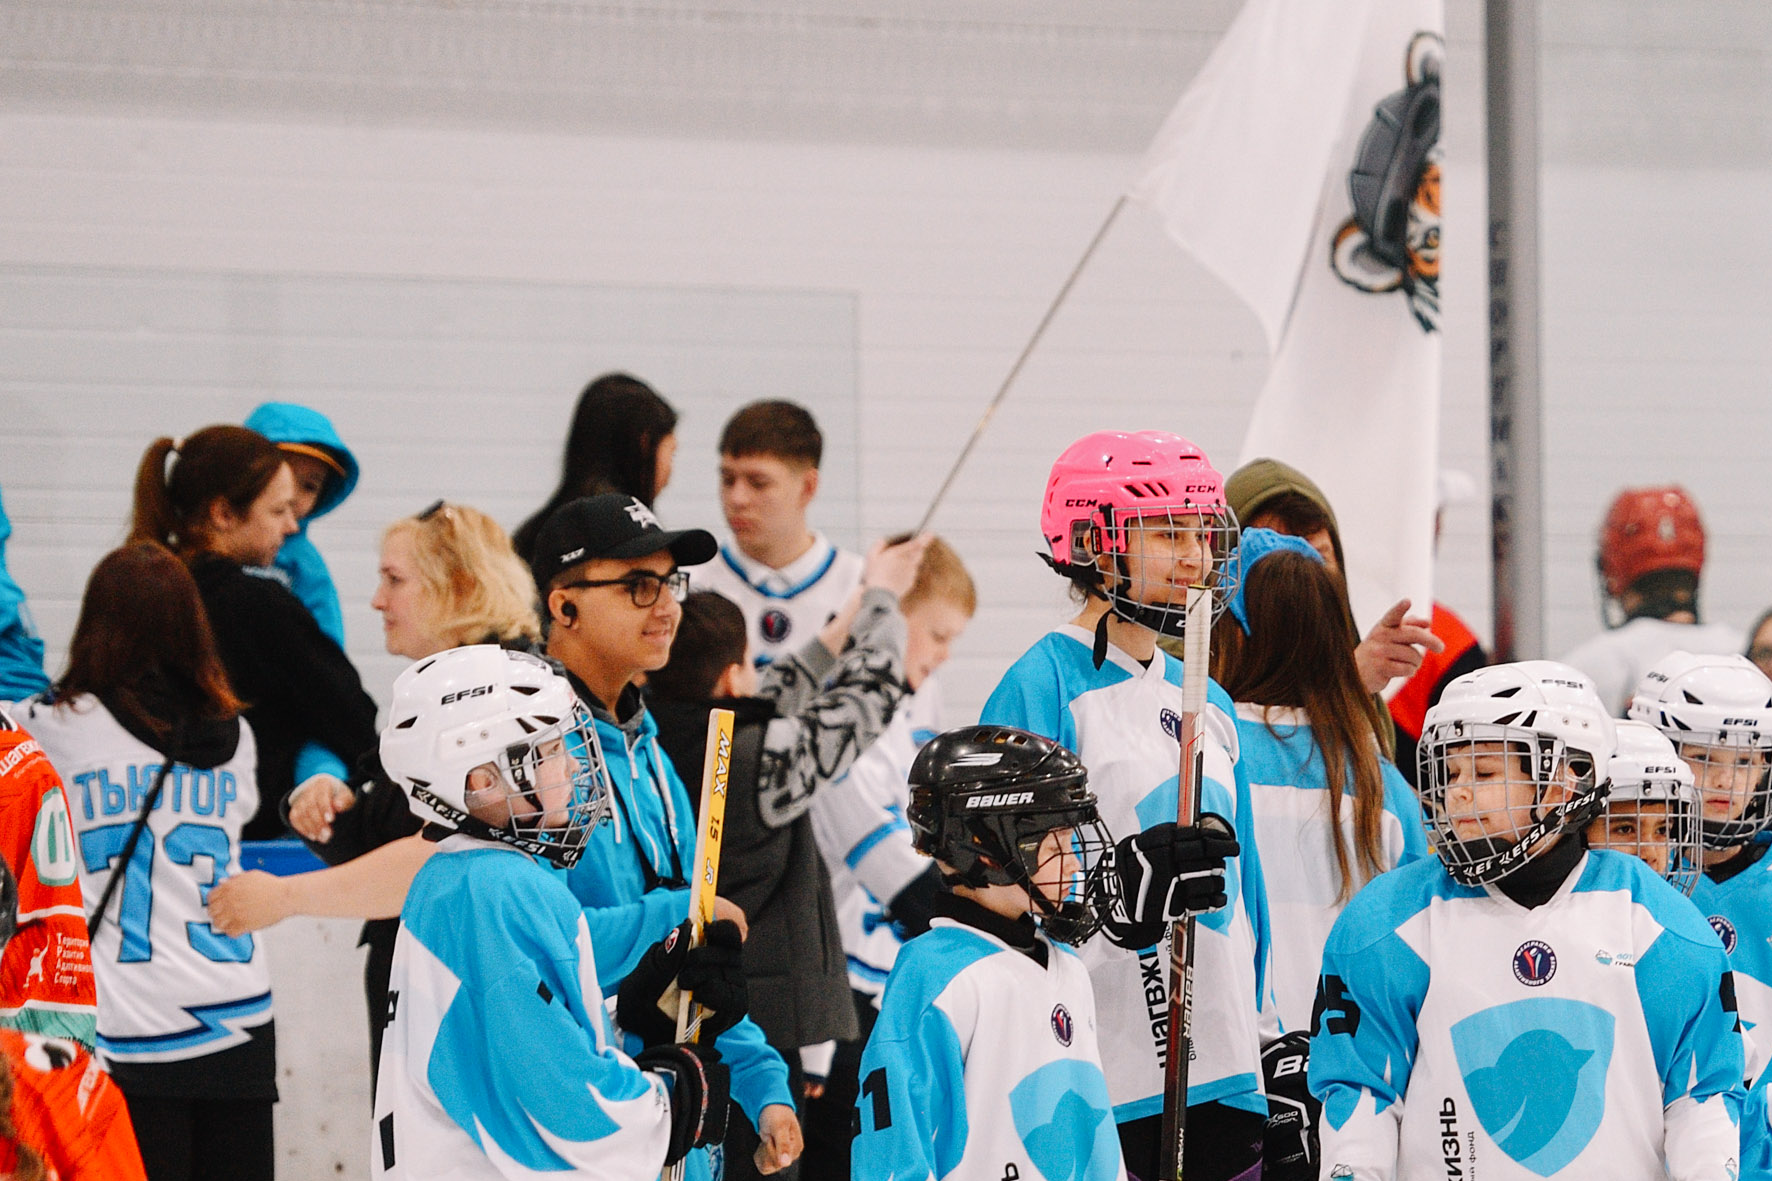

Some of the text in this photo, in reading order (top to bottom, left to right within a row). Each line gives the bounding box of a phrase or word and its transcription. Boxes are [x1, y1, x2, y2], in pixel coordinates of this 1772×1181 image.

[1185, 485, 1216, 493] CCM
[1065, 499, 1098, 507] CCM
[441, 684, 494, 705] EFSI
[1723, 717, 1758, 727] EFSI
[713, 731, 731, 798] MAX
[1644, 766, 1677, 774] EFSI
[1564, 791, 1596, 814] EFSI
[1512, 823, 1546, 857] EFSI
[78, 820, 255, 963] 73
[1464, 1130, 1476, 1164] фонд
